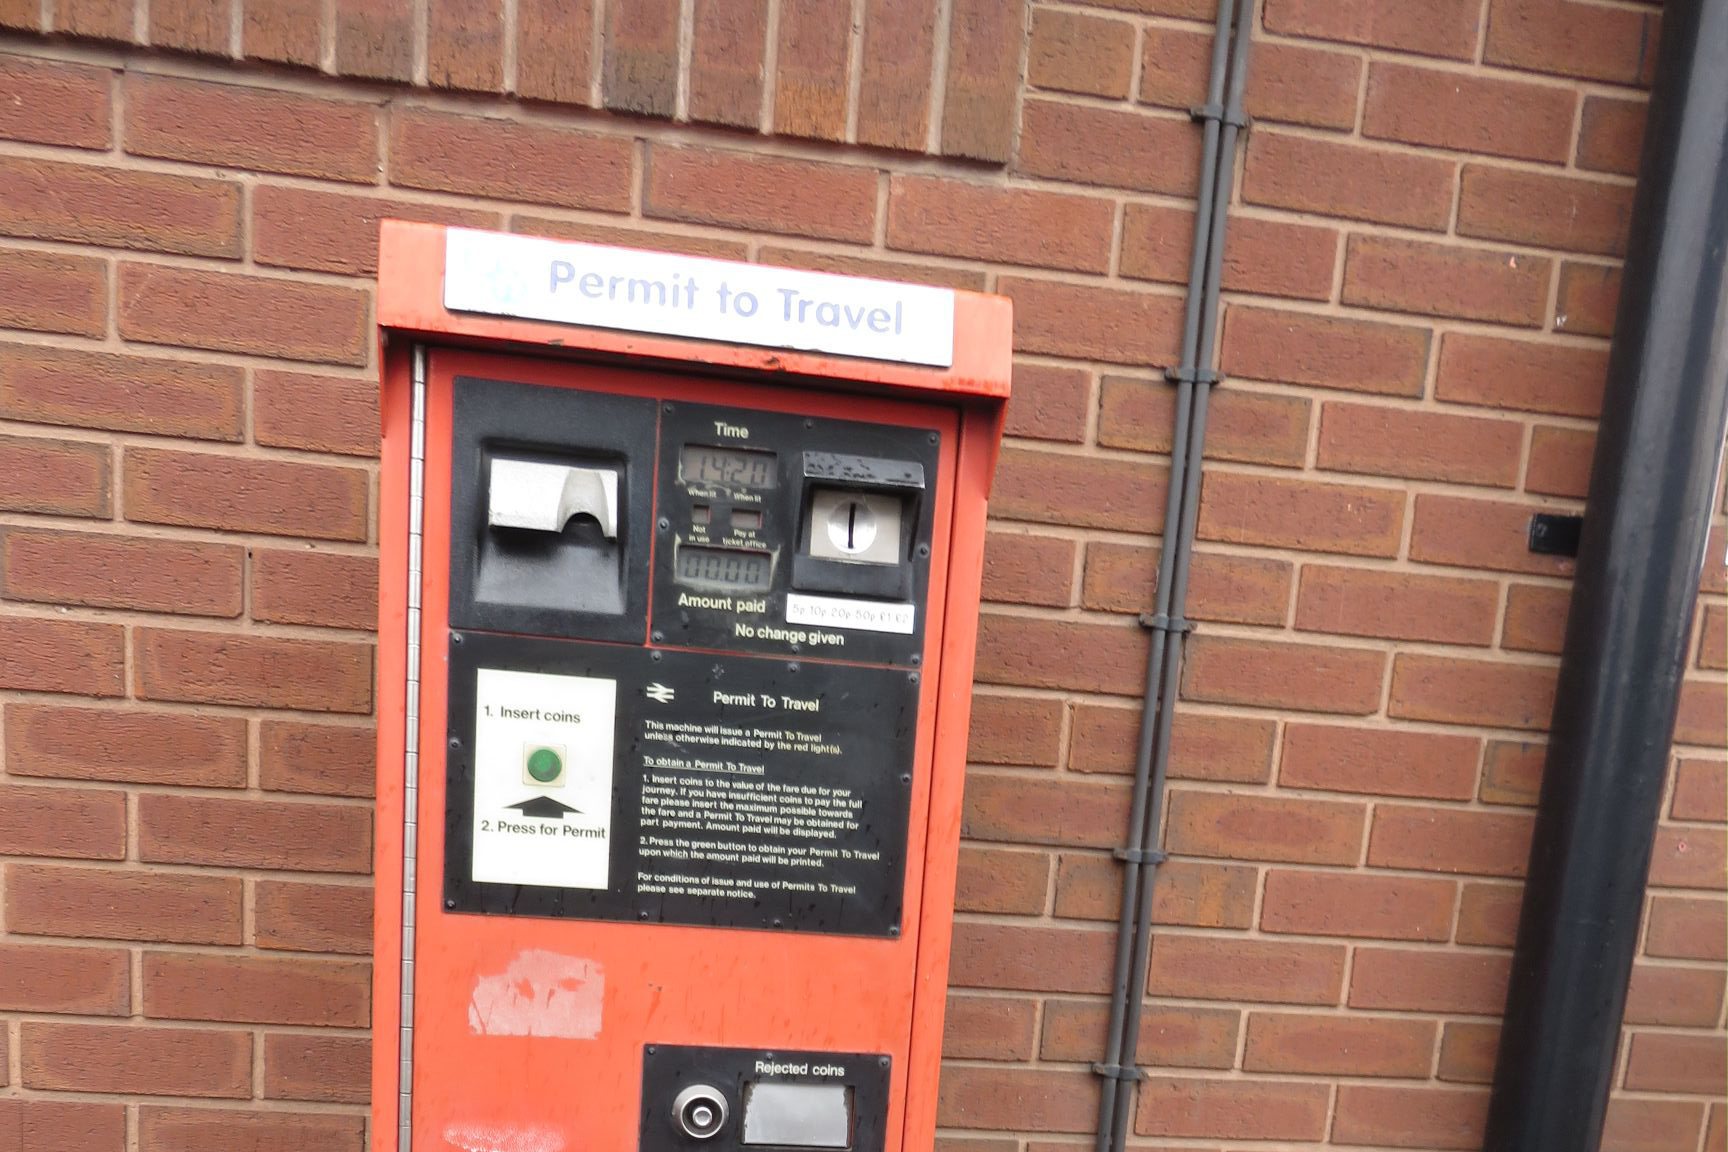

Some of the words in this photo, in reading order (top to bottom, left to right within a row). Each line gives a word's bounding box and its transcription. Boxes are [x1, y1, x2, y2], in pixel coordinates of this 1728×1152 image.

[550, 260, 700, 310] Permit
[717, 281, 759, 317] to
[777, 288, 902, 335] Travel
[714, 421, 749, 438] Time
[688, 488, 708, 496] When
[709, 490, 717, 498] lit
[733, 493, 754, 501] When
[693, 525, 706, 533] Not
[734, 529, 746, 538] Pay
[748, 530, 755, 538] at
[722, 537, 743, 546] ticket
[745, 540, 767, 549] office
[678, 593, 732, 610] Amount
[737, 599, 765, 613] paid
[735, 624, 754, 637] No
[757, 626, 806, 643] change
[809, 630, 845, 645] given
[714, 690, 755, 706] Permit
[761, 694, 776, 708] To
[781, 696, 819, 712] Travel
[484, 705, 493, 717] 1.
[500, 706, 540, 720] Insert
[544, 710, 581, 724] coins
[645, 720, 664, 730] This
[666, 722, 702, 733] machine
[704, 725, 718, 734] will
[720, 727, 743, 736] issue
[753, 729, 782, 739] Permit
[784, 731, 795, 740] To
[796, 731, 822, 742] Travel
[645, 732, 673, 742] unless
[675, 734, 719, 745] otherwise
[721, 736, 761, 748] indicated
[764, 740, 774, 750] by
[777, 741, 791, 750] the
[794, 743, 808, 751] red
[643, 756, 654, 765] To
[657, 757, 684, 767] obtain
[695, 760, 723, 770] Permit
[726, 761, 737, 771] To
[739, 762, 764, 773] Travel
[643, 774, 649, 783] 1.
[652, 774, 677, 784] Insert
[679, 777, 703, 786] coins
[706, 779, 715, 787] to
[716, 779, 730, 788] the
[732, 780, 754, 789] value
[767, 783, 781, 791] the
[783, 784, 799, 793] fare
[801, 786, 817, 794] due
[819, 787, 830, 795] for
[832, 789, 851, 798] your
[642, 785, 678, 796] journey.
[706, 789, 727, 799] have
[729, 791, 777, 802] insufficient
[780, 795, 802, 804] coins
[815, 800, 830, 808] pay
[833, 799, 846, 808] the
[849, 800, 862, 808] full
[642, 796, 659, 804] fare
[661, 798, 690, 807] please
[692, 800, 717, 809] insert
[720, 801, 734, 810] the
[736, 803, 777, 813] maximum
[780, 806, 816, 816] possible
[819, 808, 853, 818] towards
[641, 806, 656, 815] the
[658, 808, 675, 817] fare
[678, 810, 694, 818] and
[704, 810, 732, 821] Permit
[735, 813, 745, 821] To
[747, 814, 772, 824] Travel
[774, 817, 792, 826] may
[794, 817, 804, 826] be
[807, 819, 844, 829] obtained
[847, 820, 859, 830] for
[481, 820, 494, 832] 2.
[498, 821, 536, 834] Press
[540, 824, 558, 836] for
[563, 825, 606, 839] Permit
[641, 818, 659, 827] part
[663, 820, 703, 829] payment.
[706, 821, 740, 832] Amount
[742, 824, 761, 834] paid
[764, 825, 778, 834] will
[780, 826, 790, 835] be
[793, 828, 837, 839] displayed.
[639, 848, 661, 857] upon
[663, 849, 688, 859] which
[691, 851, 704, 859] the
[706, 853, 739, 861] amount
[742, 854, 760, 863] paid
[762, 854, 776, 863] will
[778, 855, 788, 864] be
[791, 857, 824, 867] printed.
[640, 836, 648, 845] 2.
[649, 836, 674, 846] Press
[676, 839, 689, 847] the
[691, 841, 716, 849] green
[718, 841, 746, 851] button
[749, 843, 757, 852] to
[759, 845, 785, 853] obtain
[788, 846, 806, 855] your
[809, 847, 838, 857] Permit
[841, 849, 851, 858] To
[854, 850, 880, 860] Travel
[637, 872, 652, 880] For
[654, 873, 699, 884] conditions
[701, 876, 710, 884] of
[712, 877, 734, 886] issue
[736, 879, 752, 887] and
[772, 881, 780, 889] of
[782, 881, 815, 891] Permits
[818, 883, 828, 892] To
[830, 884, 856, 894] Travel
[637, 884, 666, 893] please
[669, 886, 684, 894] see
[687, 886, 724, 896] separate
[727, 889, 756, 899] notice.
[755, 1060, 808, 1076] Rejected
[813, 1064, 845, 1076] coins
